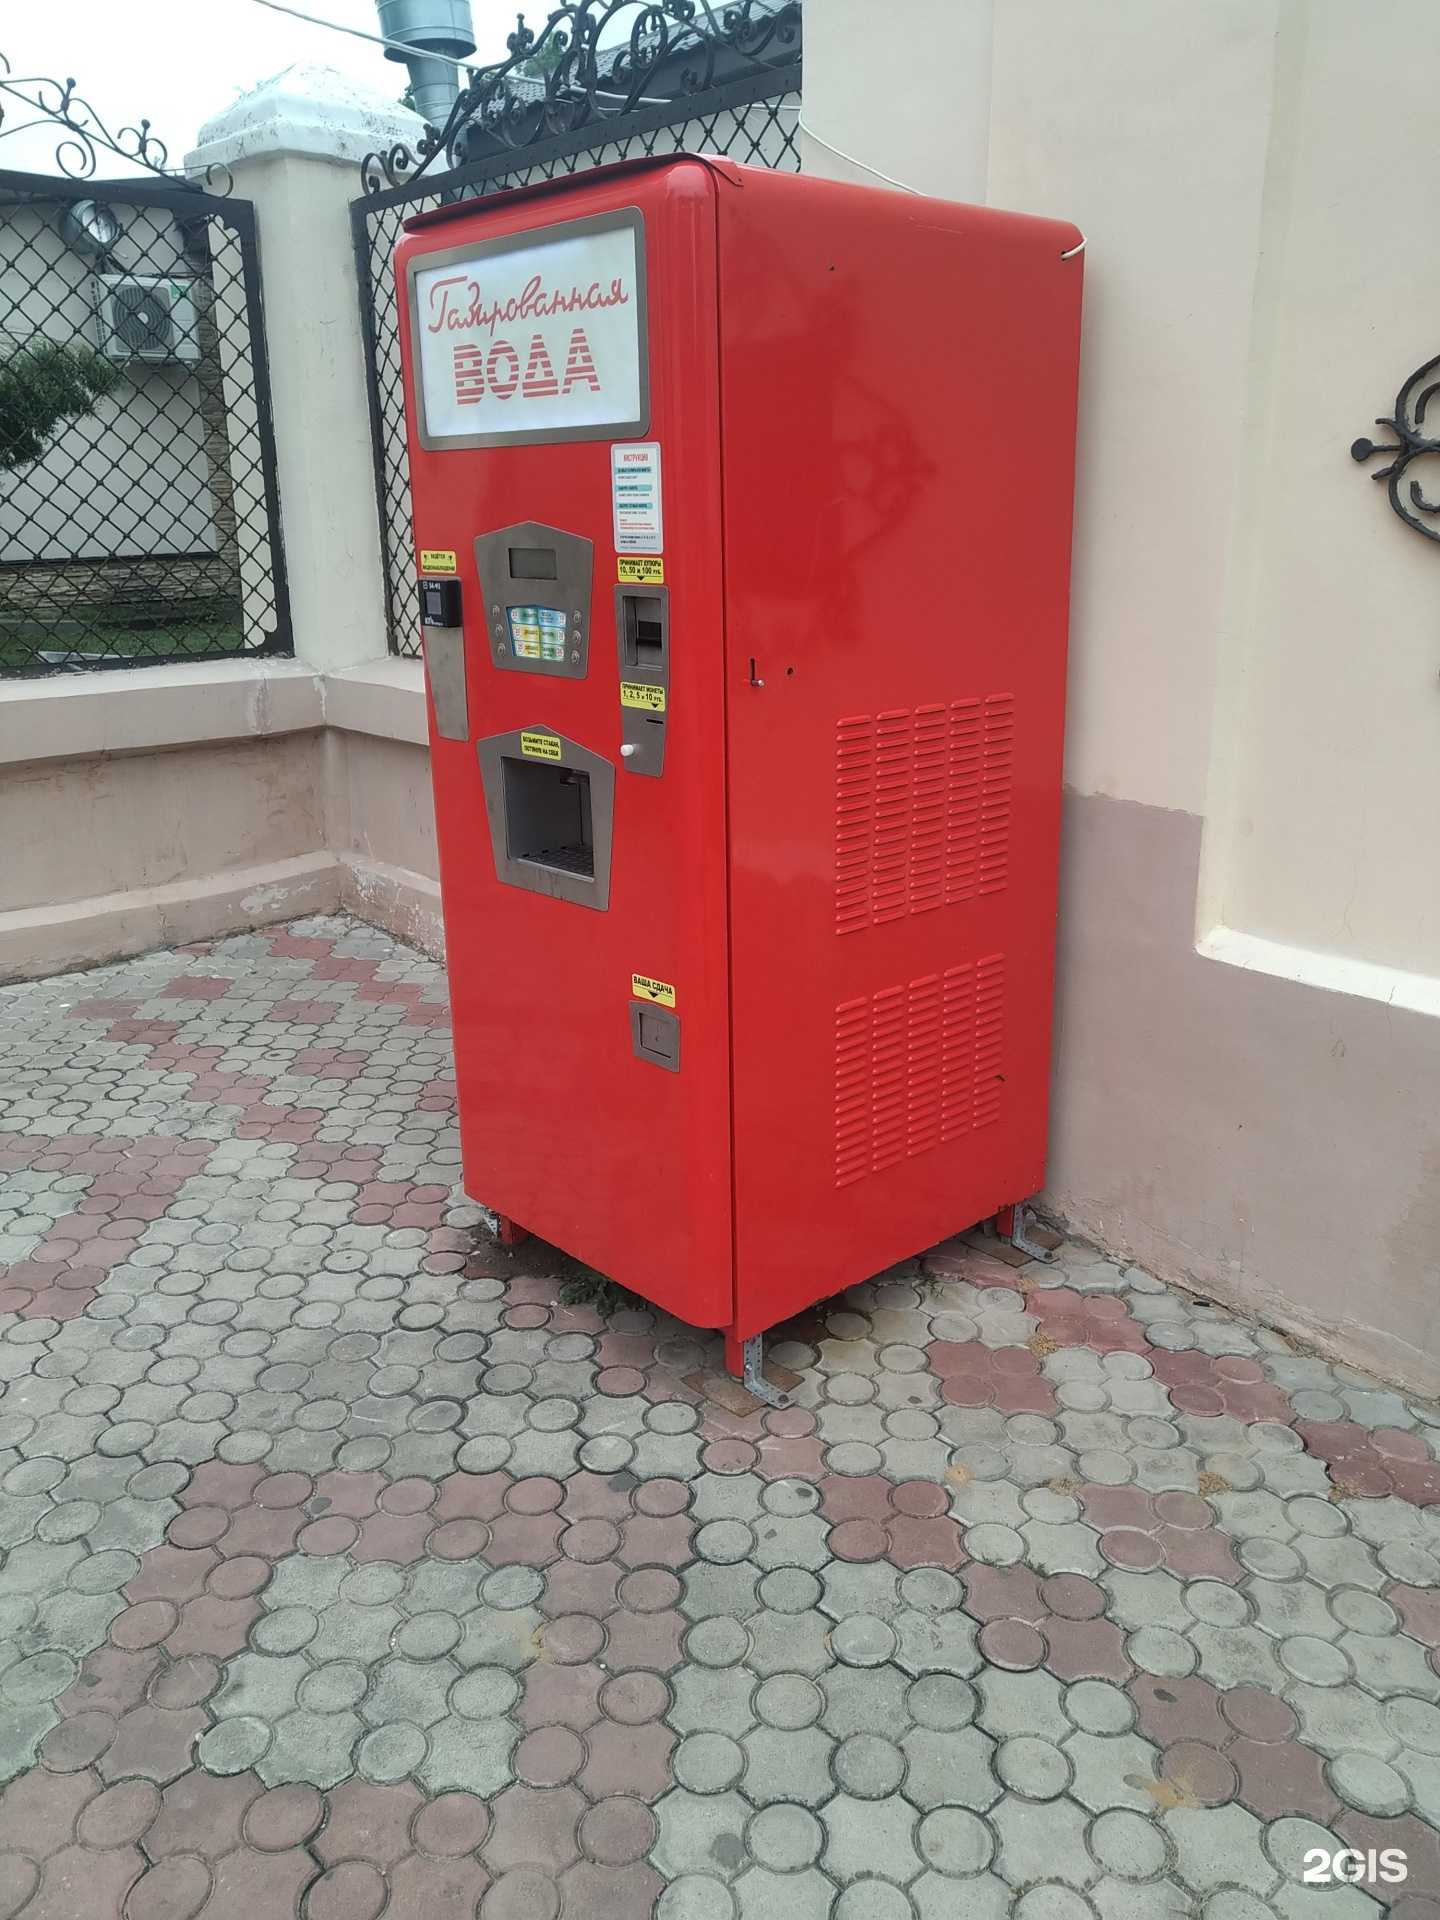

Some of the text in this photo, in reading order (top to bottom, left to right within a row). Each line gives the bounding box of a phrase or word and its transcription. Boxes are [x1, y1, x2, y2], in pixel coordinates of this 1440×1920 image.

[428, 275, 628, 336] Газированная
[453, 328, 601, 405] ВОДА
[620, 566, 628, 575] 10,
[642, 567, 652, 575] 100
[623, 690, 629, 699] 1,
[629, 691, 635, 699] 2,
[633, 975, 673, 995] ВАША СДАЧА
